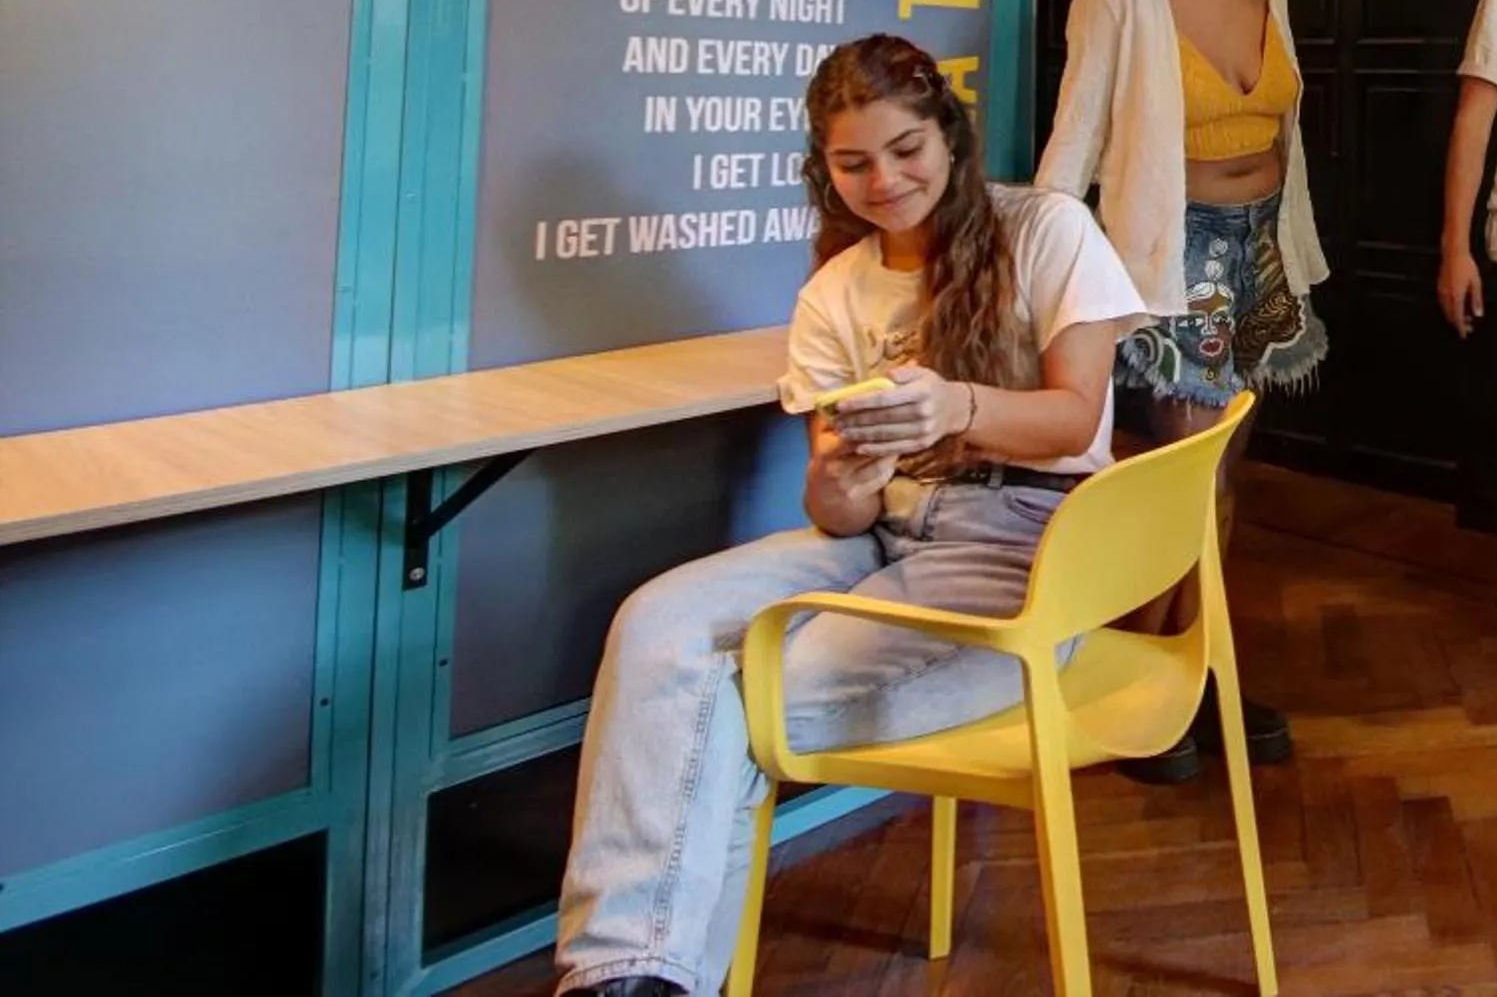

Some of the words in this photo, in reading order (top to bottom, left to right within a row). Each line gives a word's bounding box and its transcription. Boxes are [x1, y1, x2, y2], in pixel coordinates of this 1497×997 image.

[622, 36, 689, 74] AND
[697, 39, 789, 76] EVERY
[795, 43, 836, 77] DA
[644, 96, 678, 133] IN
[685, 96, 762, 132] YOUR
[768, 96, 811, 133] EY
[693, 154, 703, 190] I
[710, 153, 765, 190] GET
[770, 152, 803, 187] LO
[535, 221, 547, 260] I
[556, 217, 620, 258] GET
[628, 209, 757, 253] WASHED
[763, 206, 822, 244] AWA
